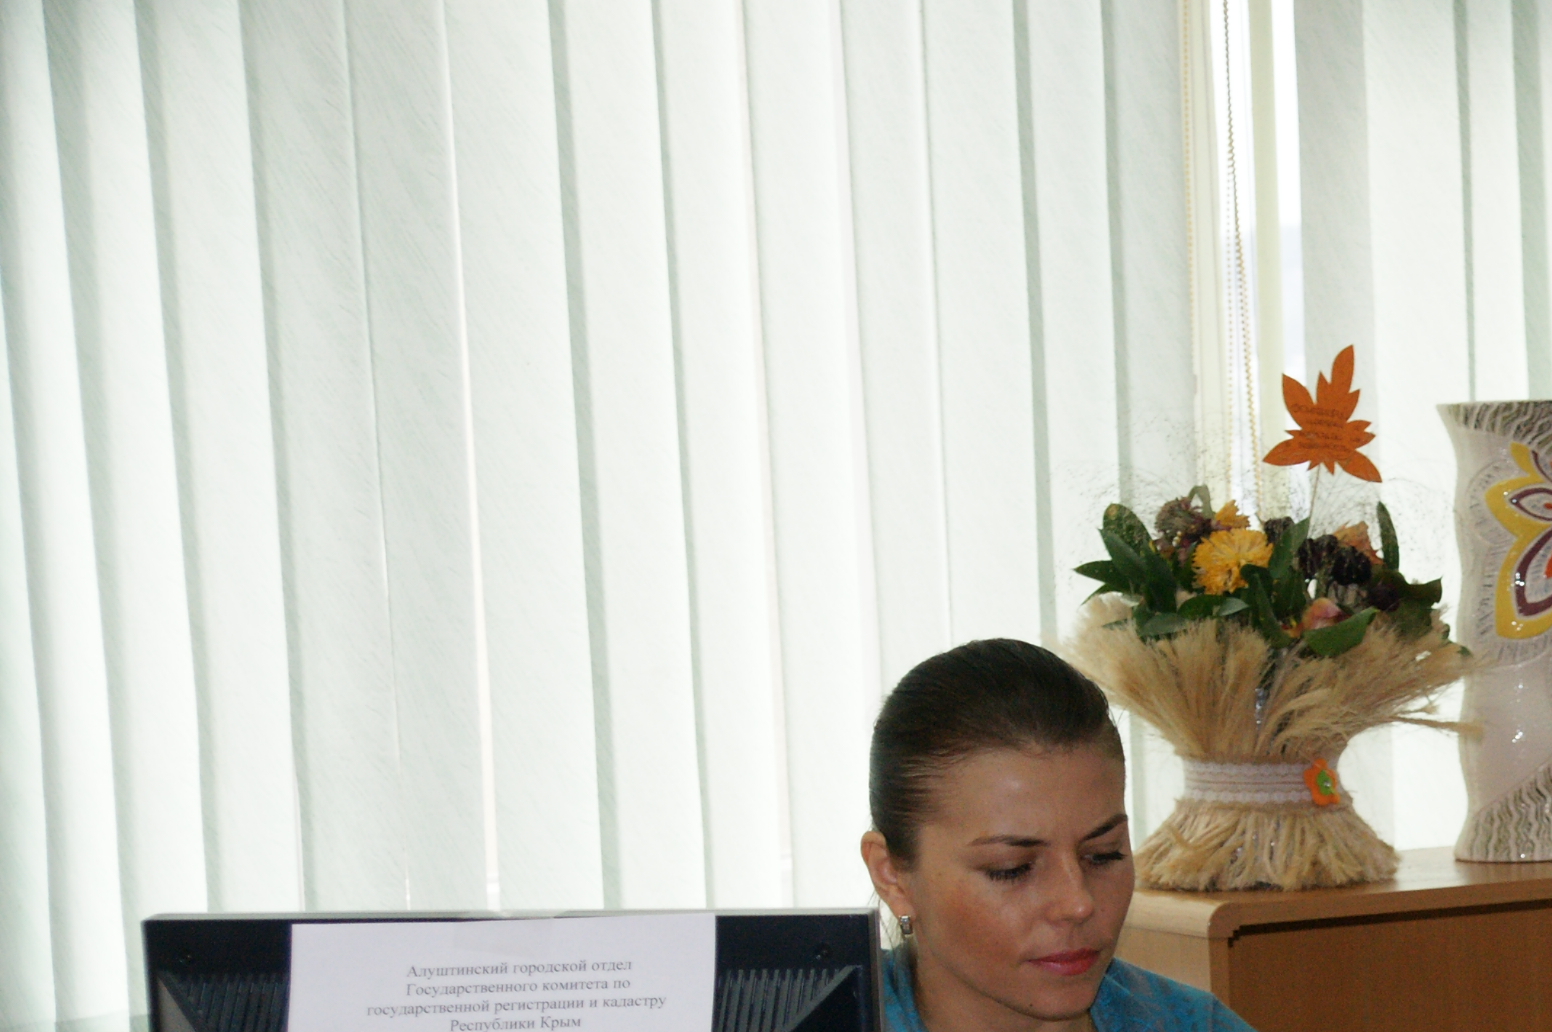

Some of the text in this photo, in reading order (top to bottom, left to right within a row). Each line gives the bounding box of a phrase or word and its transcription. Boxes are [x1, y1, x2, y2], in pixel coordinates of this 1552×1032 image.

[406, 959, 632, 981] Алуштинский городской отдел
[406, 979, 631, 999] Государственного комитета по
[367, 996, 667, 1019] государственной регистрации и кадастру
[540, 1015, 582, 1032] Крым
